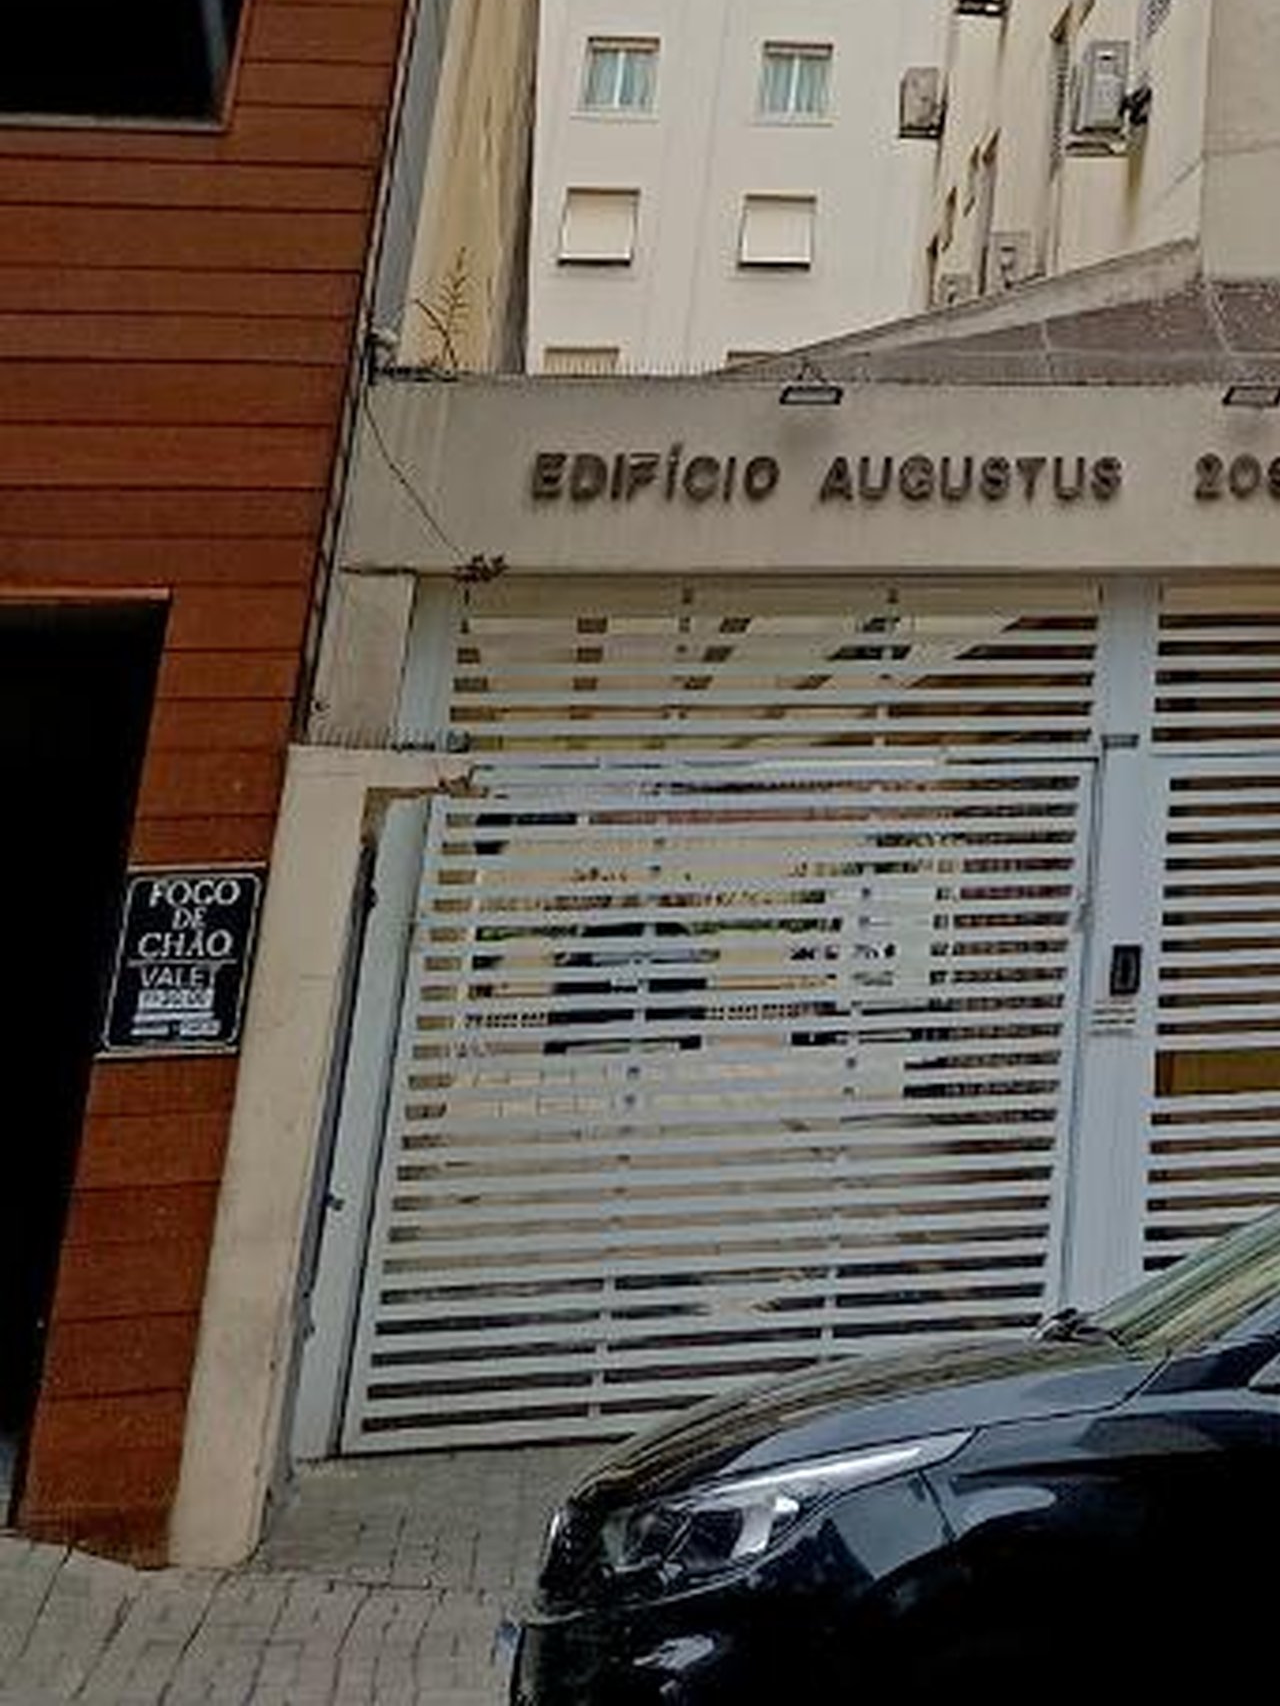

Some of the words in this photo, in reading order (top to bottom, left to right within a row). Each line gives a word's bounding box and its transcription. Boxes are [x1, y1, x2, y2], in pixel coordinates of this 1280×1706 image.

[531, 442, 780, 503] EDIFÍCIO
[820, 454, 1122, 505] AUGUSTUS
[171, 906, 207, 930] DE
